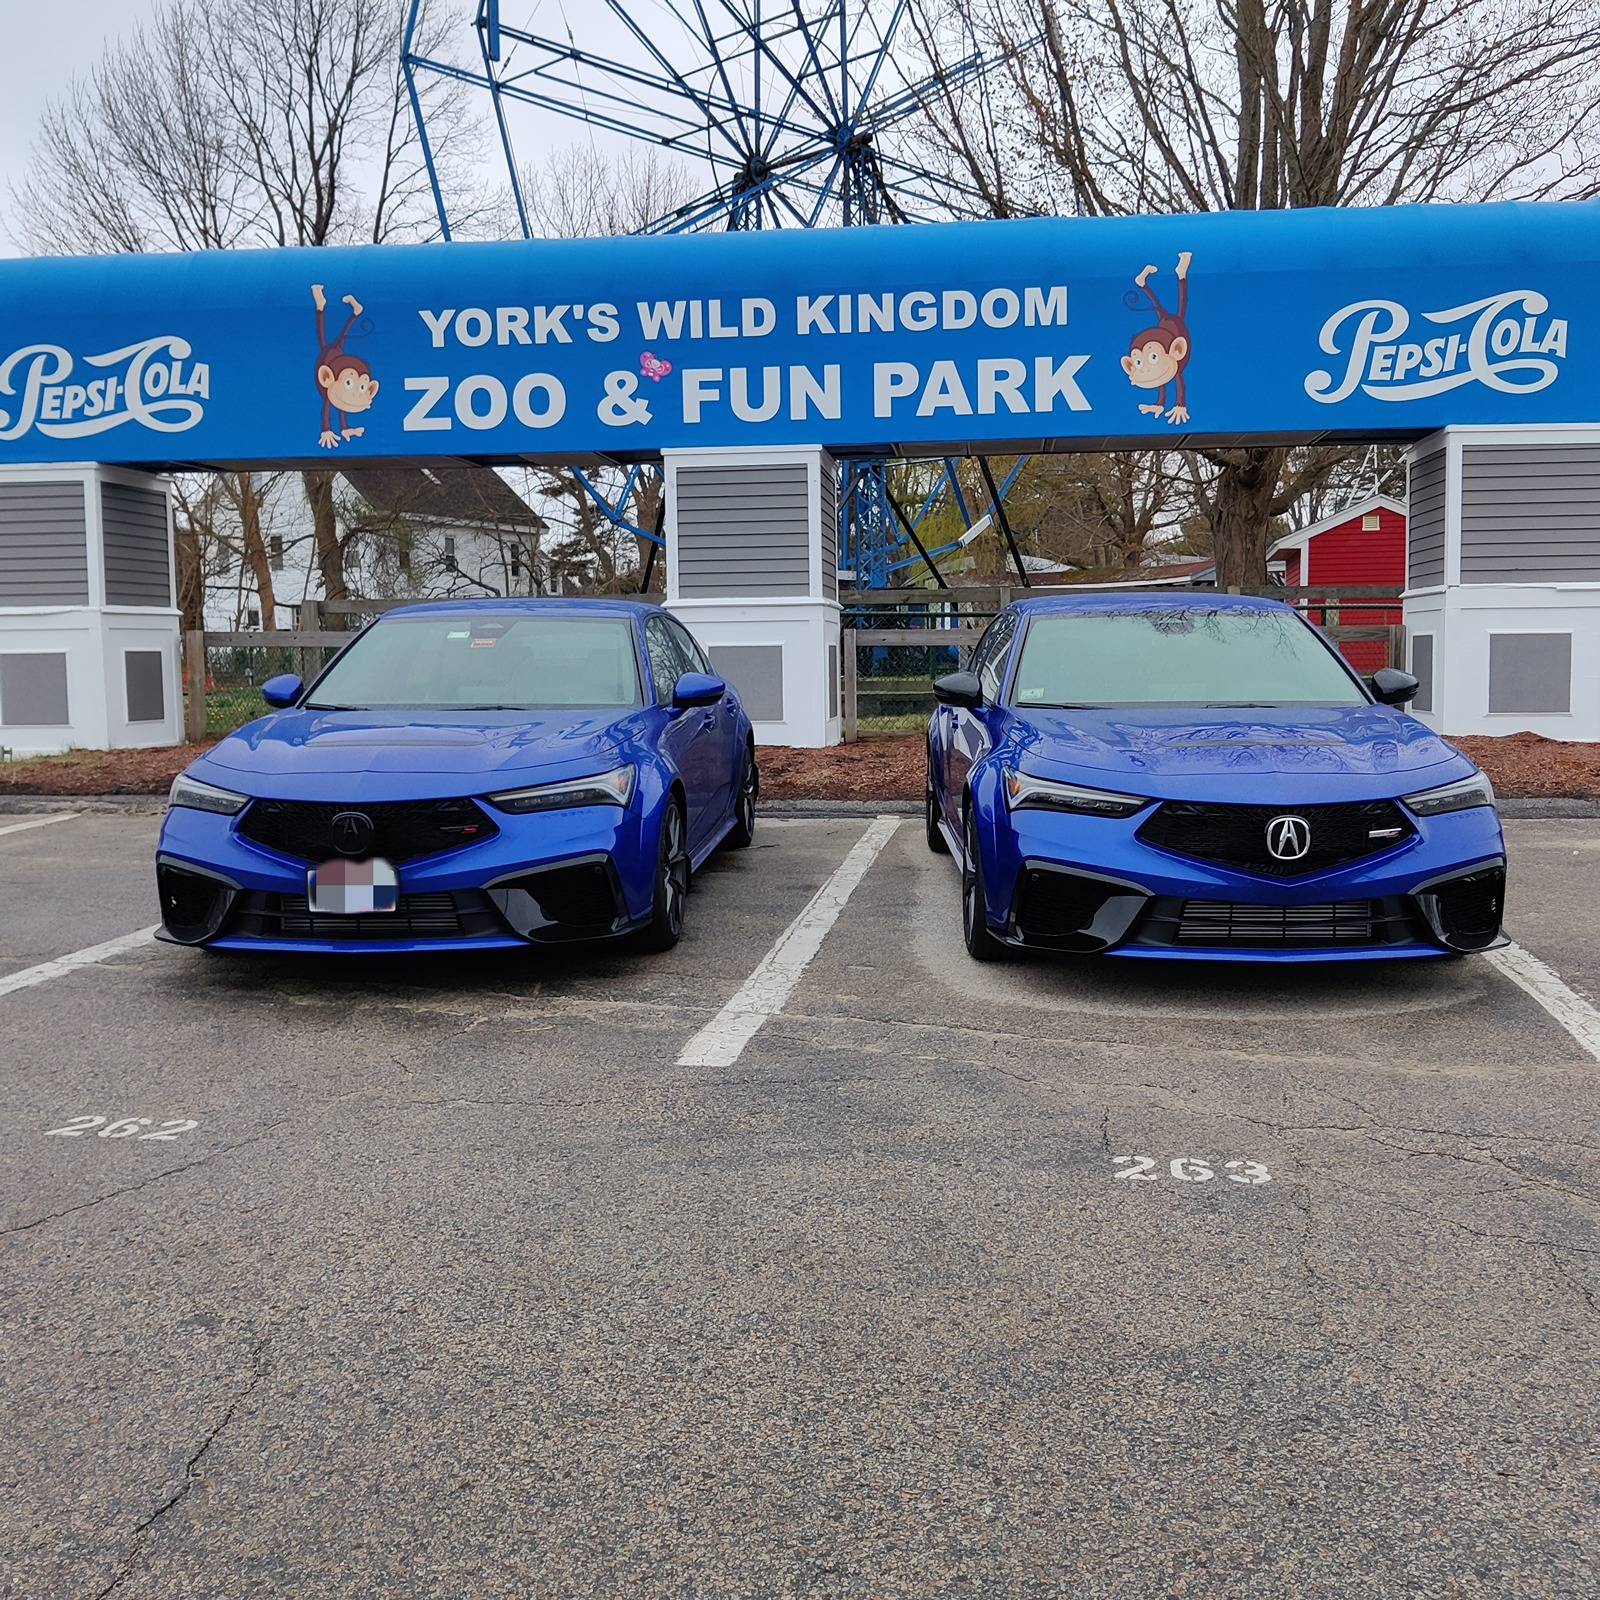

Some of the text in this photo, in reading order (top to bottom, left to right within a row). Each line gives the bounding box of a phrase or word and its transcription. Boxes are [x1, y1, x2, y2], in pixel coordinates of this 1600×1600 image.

[419, 287, 1068, 347] YORK'S WILD KINGDOM
[1305, 290, 1567, 403] PEPSI-COLA
[404, 356, 1092, 431] ZOO & FUN PARK
[44, 1115, 199, 1141] 262
[1112, 1155, 1273, 1184] 263
